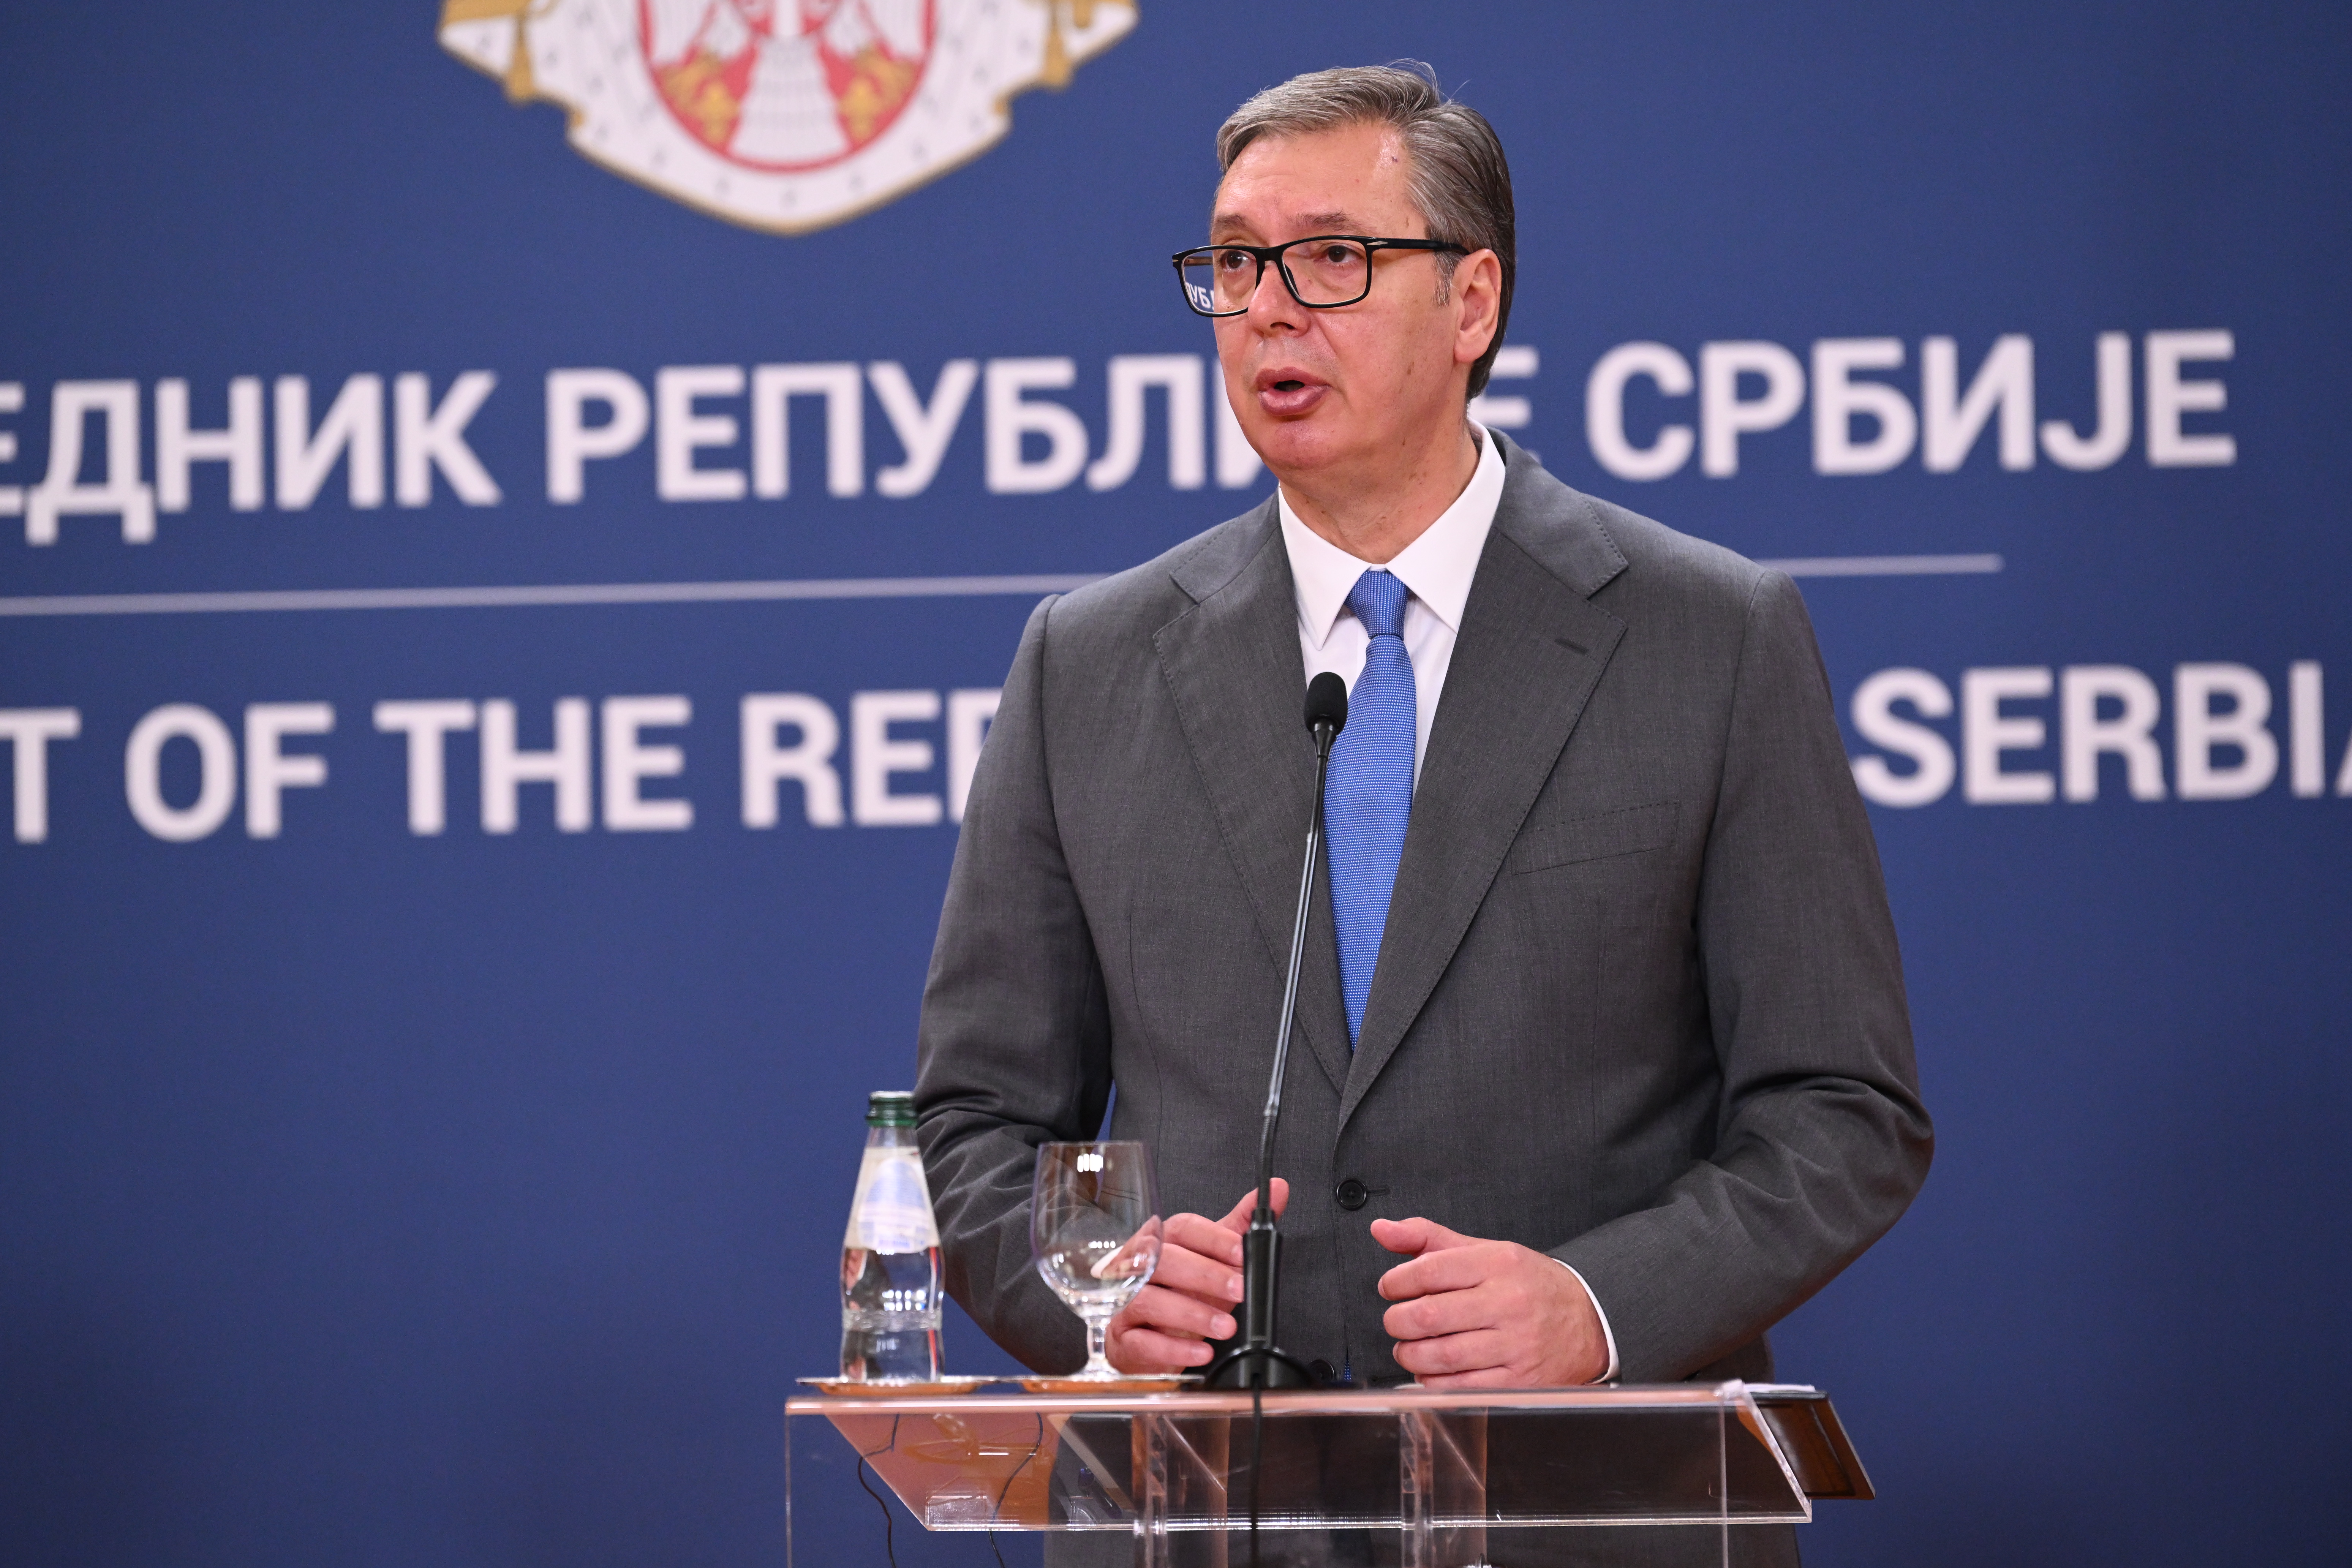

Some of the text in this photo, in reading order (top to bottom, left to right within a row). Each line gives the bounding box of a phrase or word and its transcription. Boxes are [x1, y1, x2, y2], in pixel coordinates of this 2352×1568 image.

[546, 346, 1540, 503] РЕПУБЛ
[1585, 330, 2236, 481] СРБИЈЕ
[125, 703, 334, 841] OF
[374, 696, 694, 835] THE
[1852, 660, 2352, 807] SERBI
